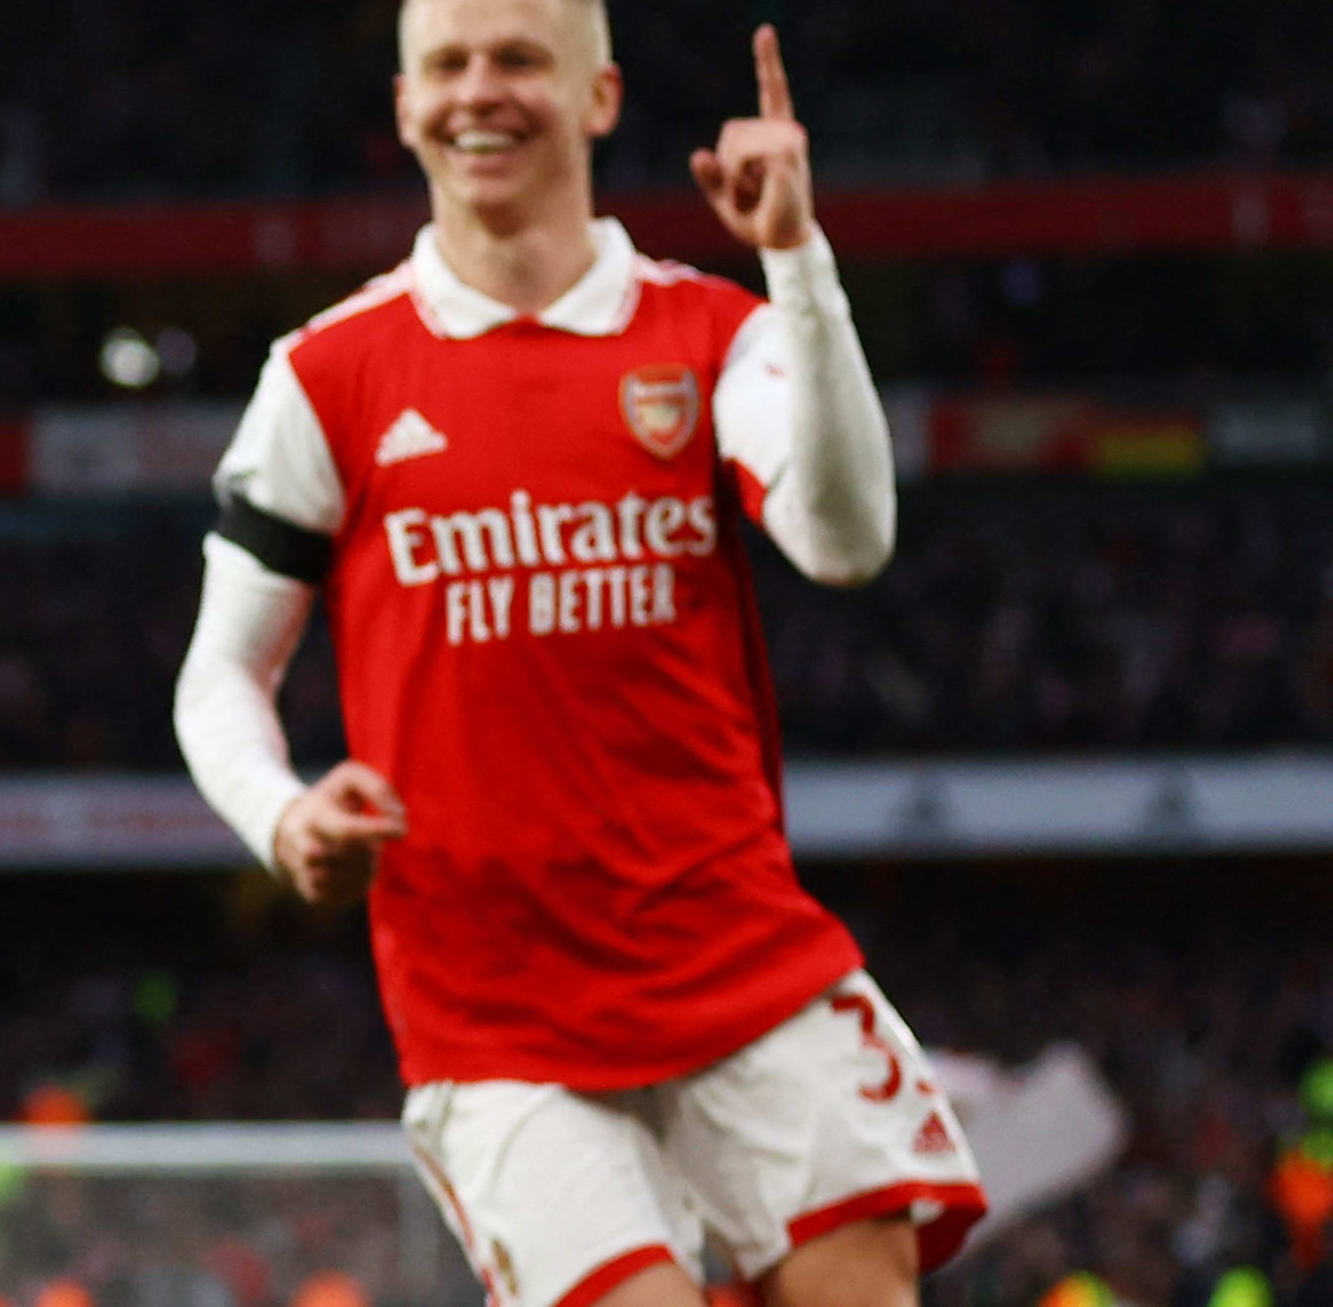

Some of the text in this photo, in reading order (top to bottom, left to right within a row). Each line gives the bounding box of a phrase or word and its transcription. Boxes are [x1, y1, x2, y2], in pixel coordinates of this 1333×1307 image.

[383, 489, 718, 587] Emirates
[444, 562, 676, 645] FLY BETTER
